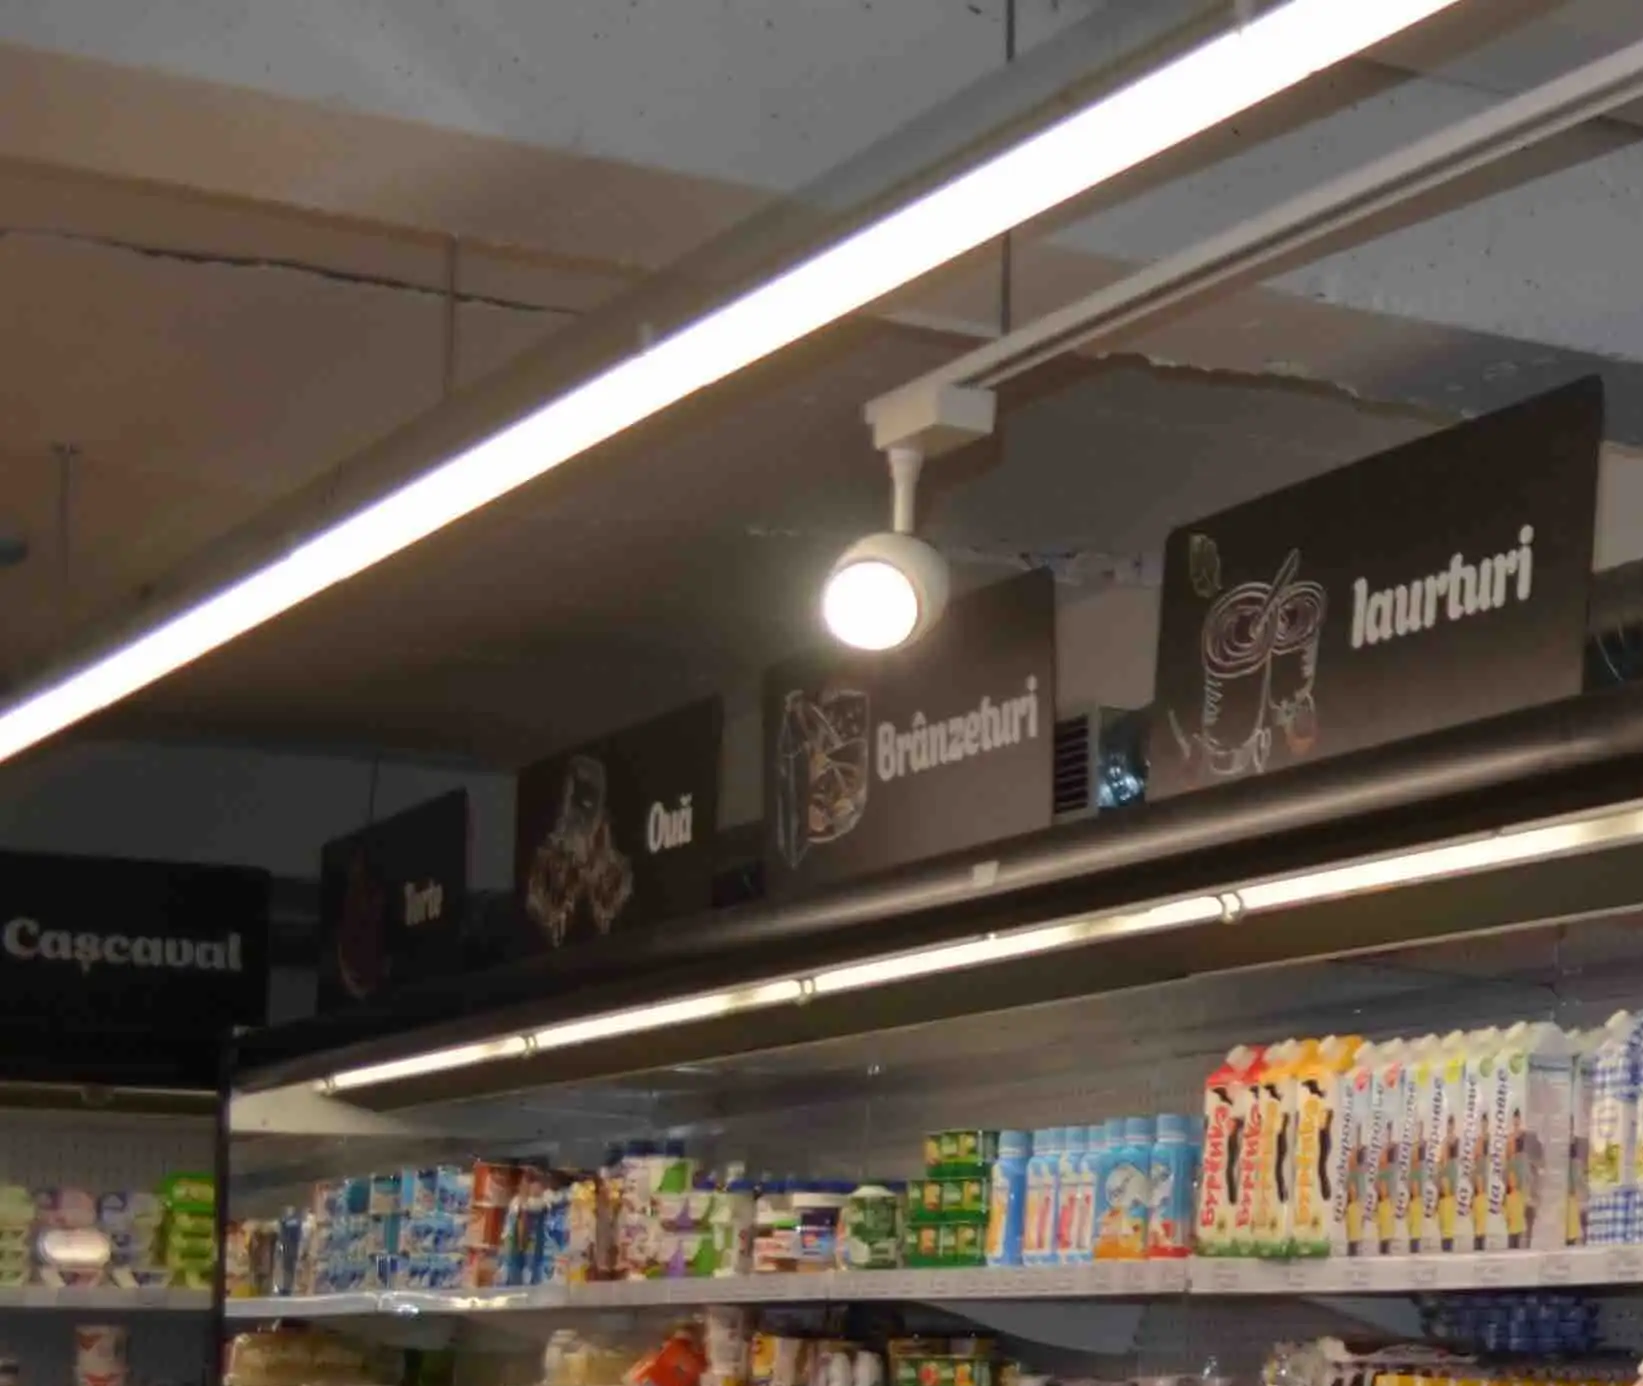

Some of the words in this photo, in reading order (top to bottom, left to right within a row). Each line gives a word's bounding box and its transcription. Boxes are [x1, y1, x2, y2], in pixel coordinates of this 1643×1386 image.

[1350, 524, 1535, 650] Iaurturi
[875, 675, 1039, 783] Brânzeturi
[646, 792, 693, 855] Ouă
